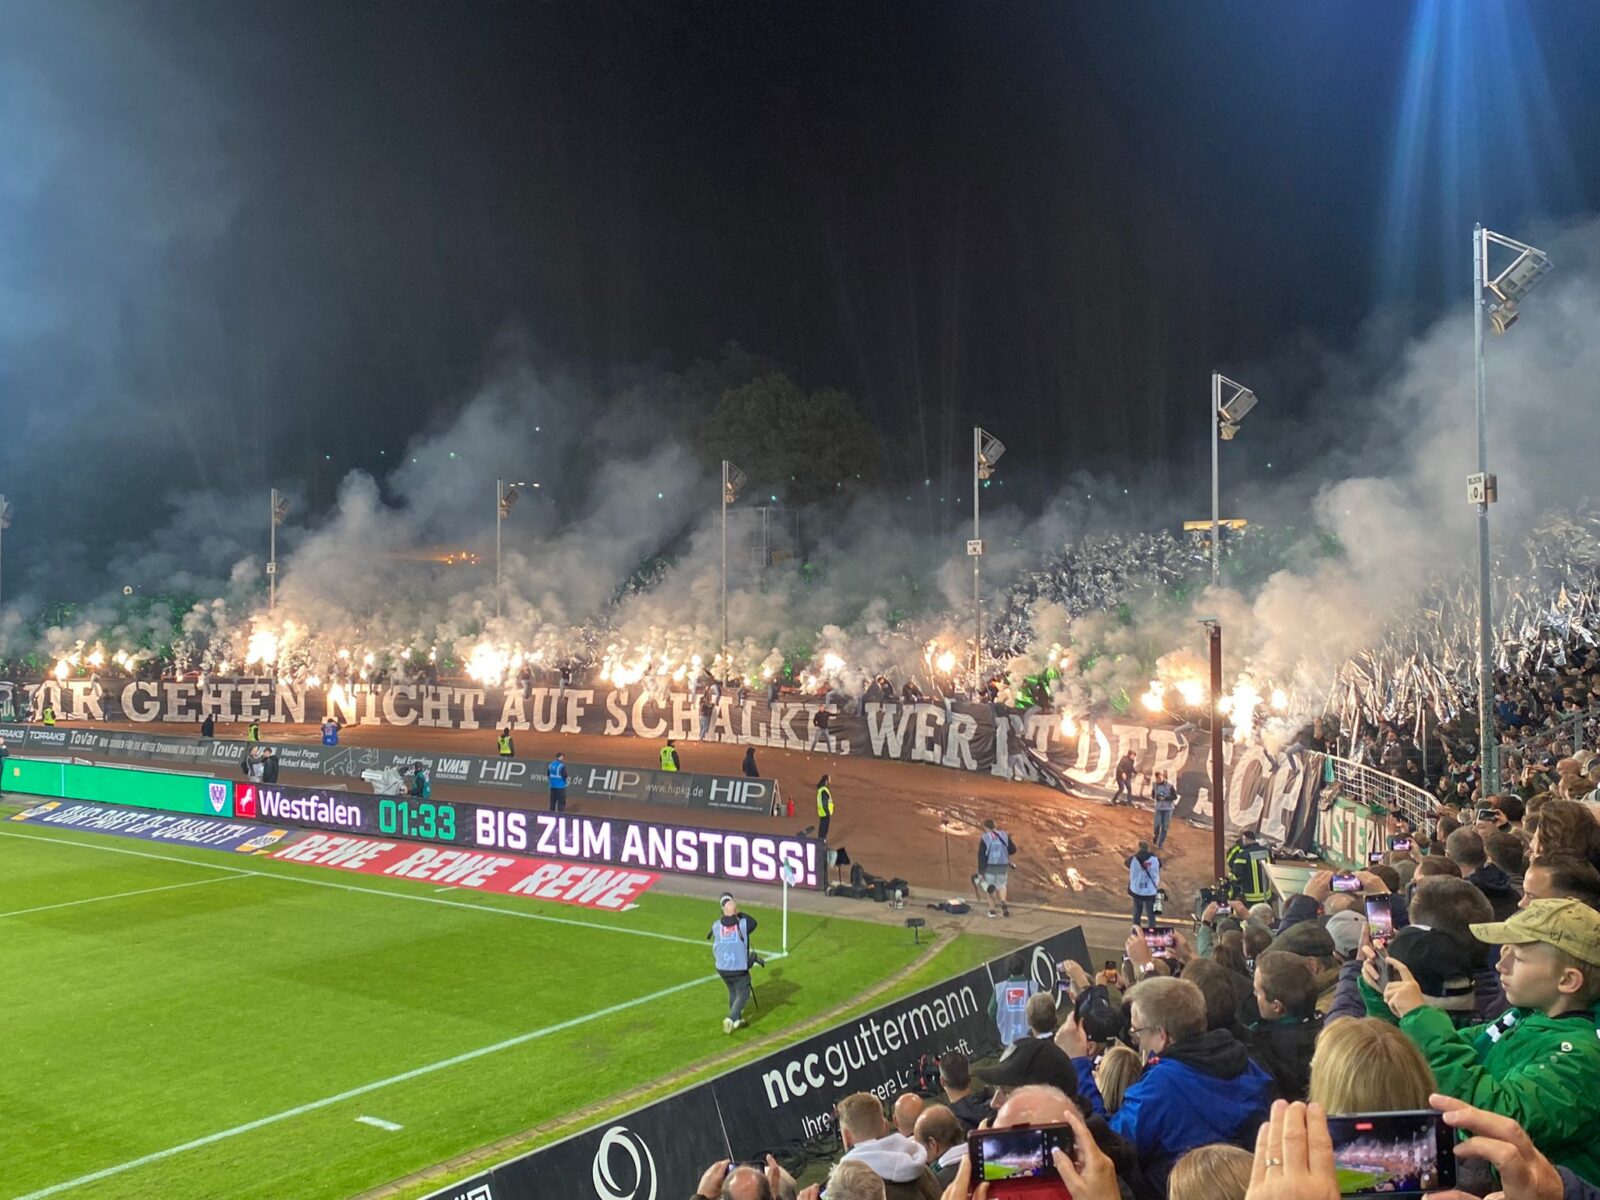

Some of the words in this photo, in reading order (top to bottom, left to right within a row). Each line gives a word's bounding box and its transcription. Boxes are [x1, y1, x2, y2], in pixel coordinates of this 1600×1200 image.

[121, 680, 305, 723] GEHEN
[321, 683, 485, 729] NICHT
[496, 687, 594, 734] AUF
[865, 702, 978, 771] WER
[437, 758, 461, 773] LVM
[480, 760, 526, 781] HIP
[588, 768, 641, 792] HIP
[259, 789, 361, 827] Westfalen
[645, 782, 704, 798] www.hipkg.de
[709, 779, 766, 804] HIP
[43, 805, 100, 828] OUR
[83, 809, 142, 833] PART
[124, 813, 167, 834] OF
[150, 817, 255, 845] QUALITY
[378, 799, 457, 841] 01:33
[273, 834, 396, 869] REWE
[475, 808, 528, 851] BIS
[536, 815, 613, 861] ZUM
[620, 823, 818, 886] ANSTOSS!
[383, 848, 516, 888] REWE
[509, 863, 652, 908] REWE
[762, 1052, 826, 1109] ncc
[824, 983, 979, 1088] guttermann
